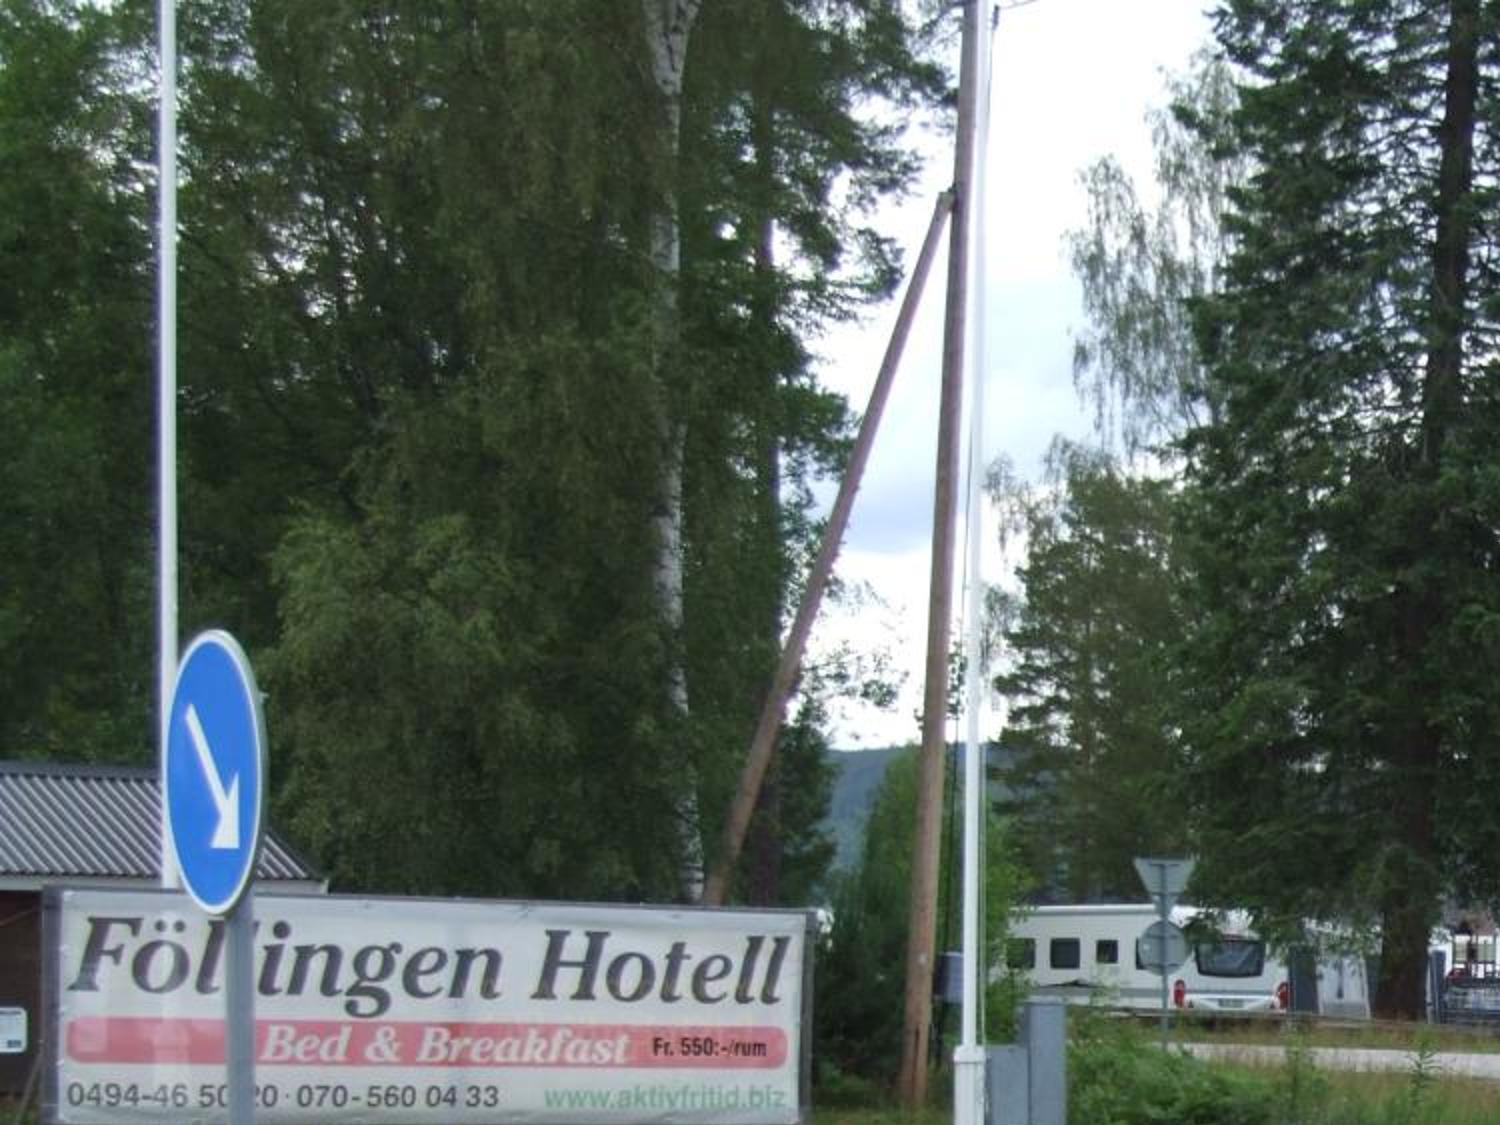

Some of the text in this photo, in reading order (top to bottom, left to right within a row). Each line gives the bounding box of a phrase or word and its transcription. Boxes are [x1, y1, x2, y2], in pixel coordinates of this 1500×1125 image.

[67, 916, 792, 1018] Fölingen Hotell
[258, 1024, 631, 1065] Bed & Breakfast
[652, 1036, 675, 1057] Fr.
[66, 1082, 188, 1108] 0494-46
[425, 1085, 457, 1108] 04
[465, 1085, 499, 1108] 33
[544, 1085, 787, 1111] www.aktivfritid.biz
